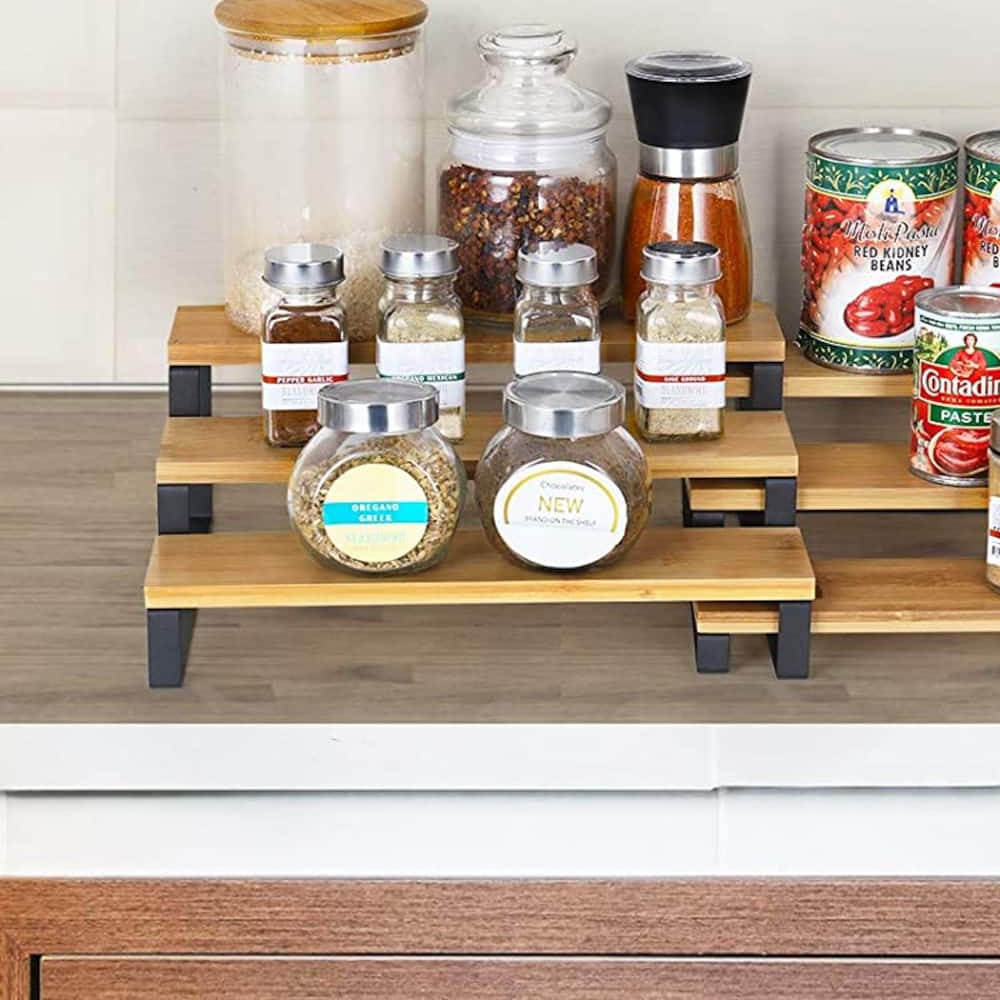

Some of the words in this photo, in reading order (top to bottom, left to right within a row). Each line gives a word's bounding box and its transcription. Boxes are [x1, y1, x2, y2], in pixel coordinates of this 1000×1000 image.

[854, 245, 878, 258] RED
[883, 245, 929, 259] KIDNEY
[980, 240, 999, 255] RED
[870, 258, 912, 271] BEANS
[940, 409, 992, 424] PASTE
[352, 503, 400, 512] OREGANO
[537, 495, 585, 514] NEW
[358, 514, 393, 522] GREEK
